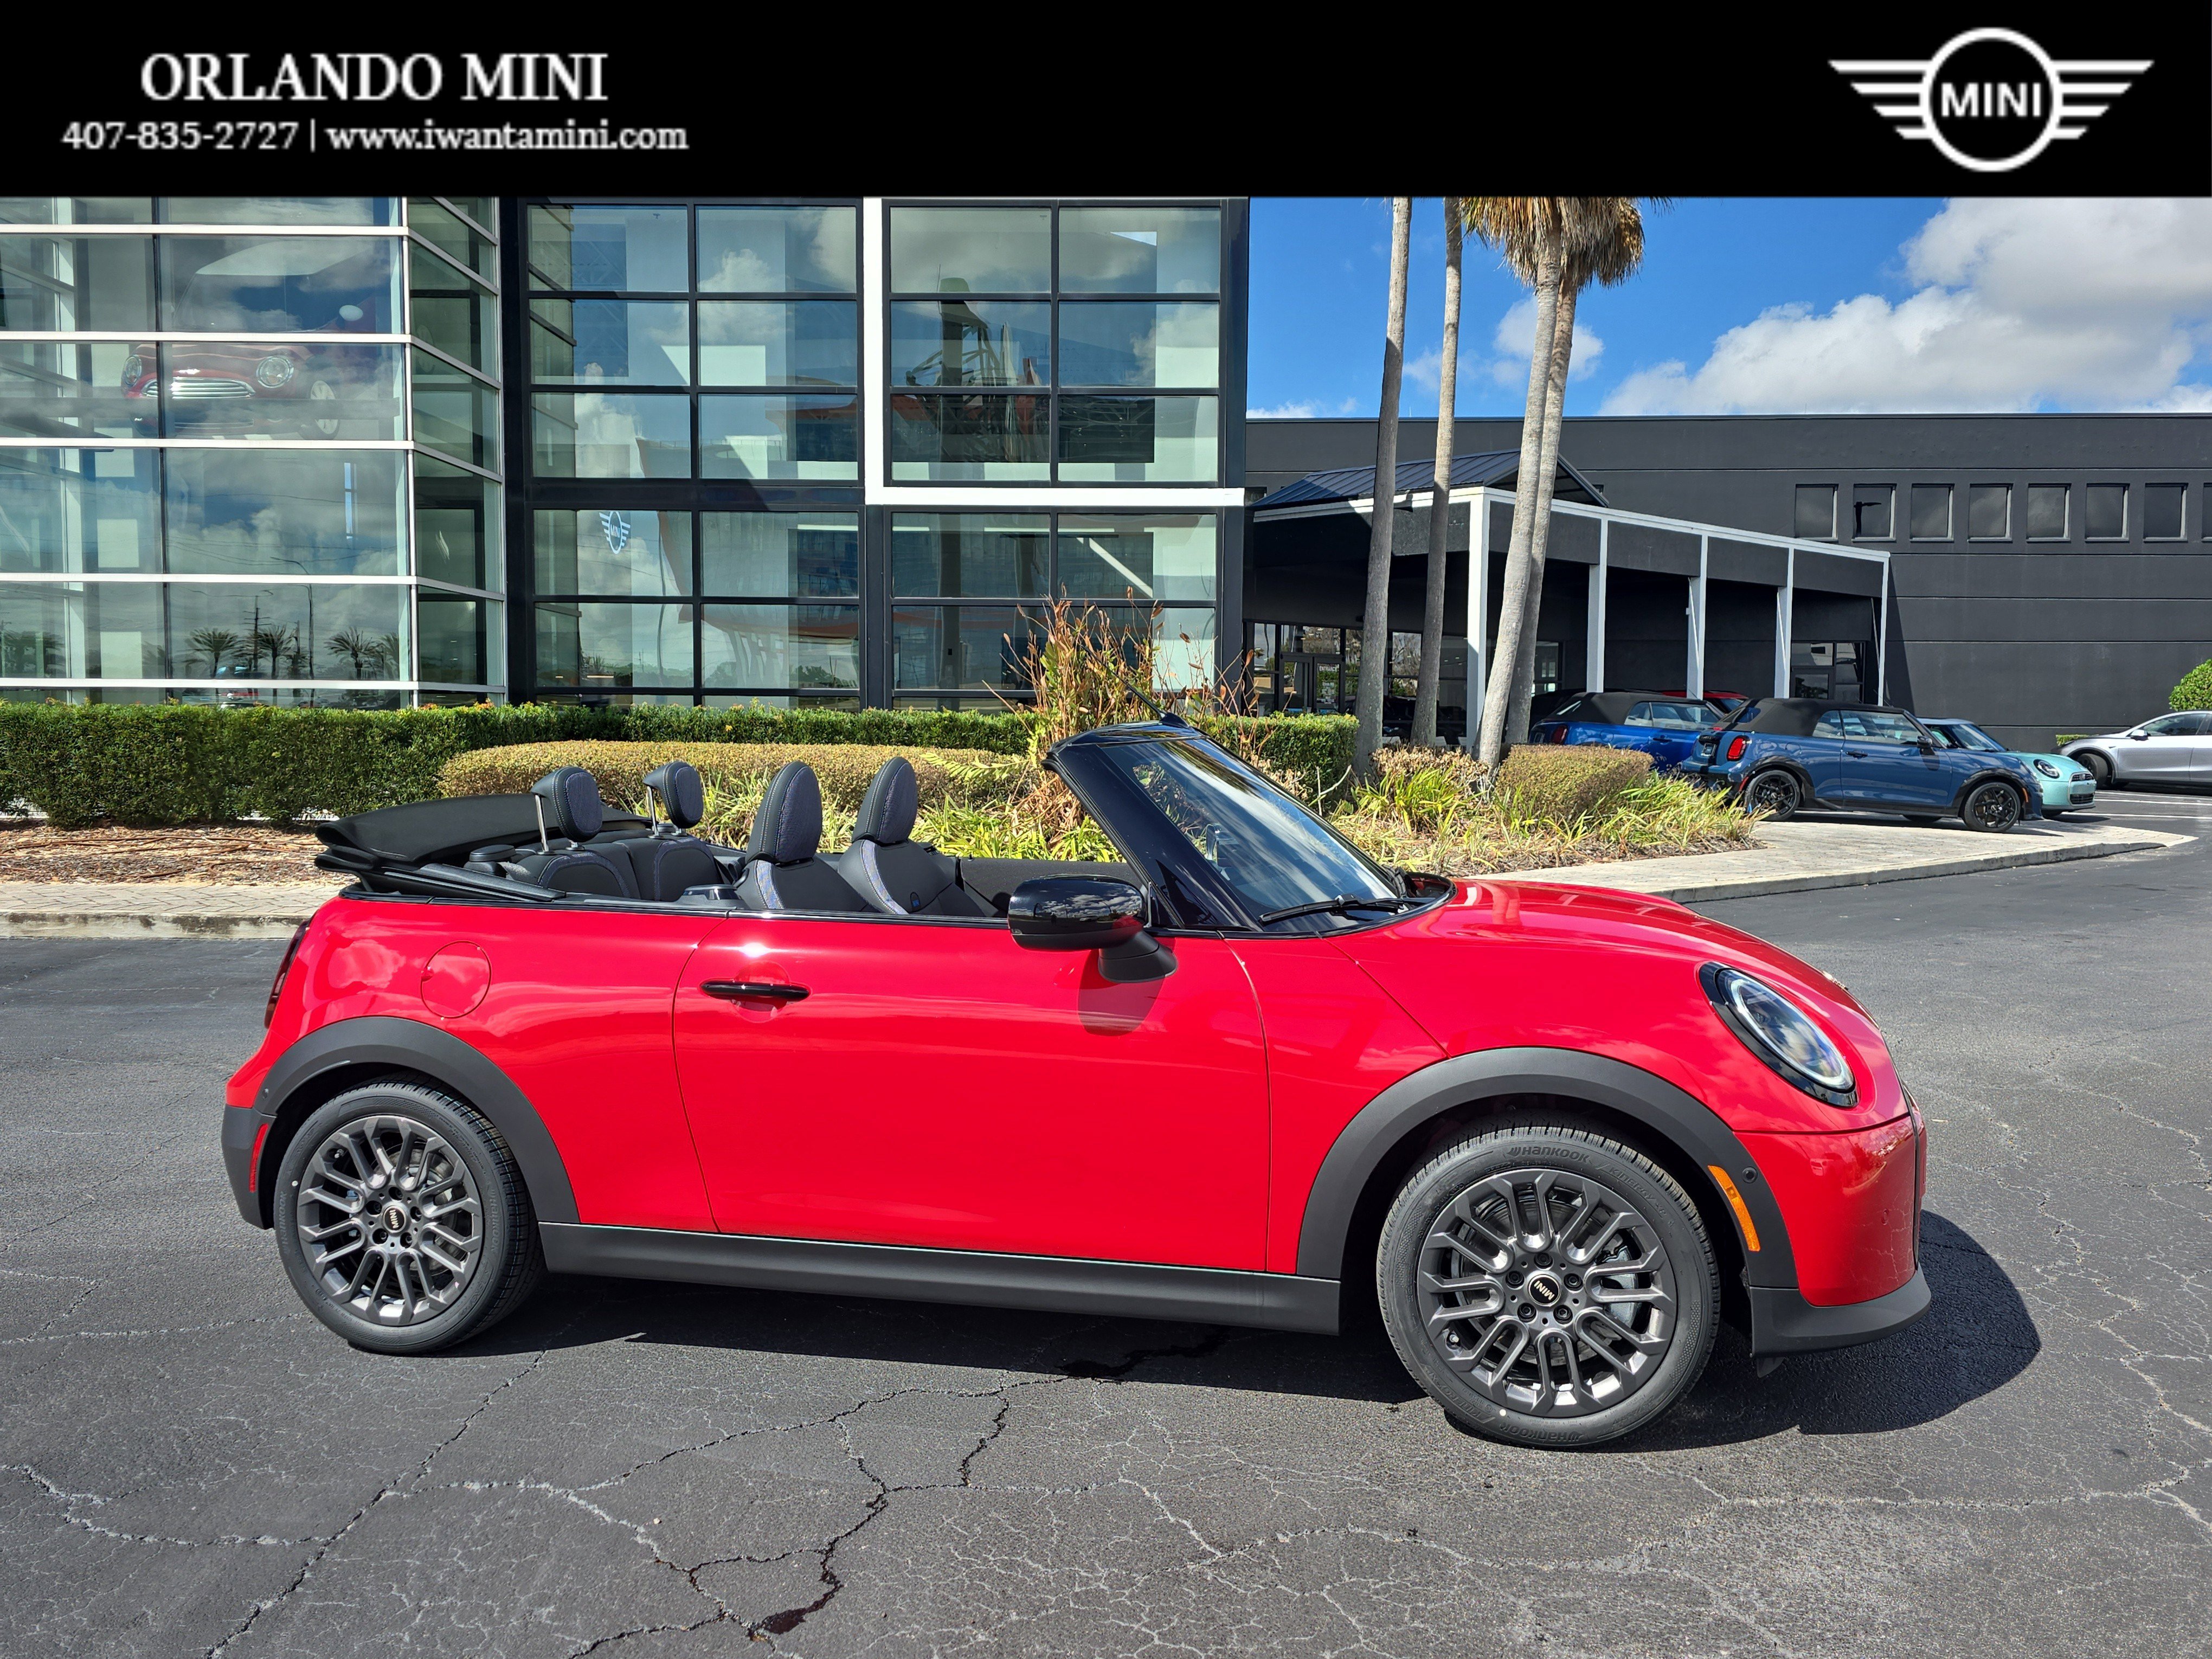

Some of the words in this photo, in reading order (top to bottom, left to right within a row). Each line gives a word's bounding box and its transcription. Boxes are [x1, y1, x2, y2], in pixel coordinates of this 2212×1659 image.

[610, 524, 621, 538] MINI
[389, 1209, 400, 1229] MINI
[1534, 1280, 1555, 1301] MINI
